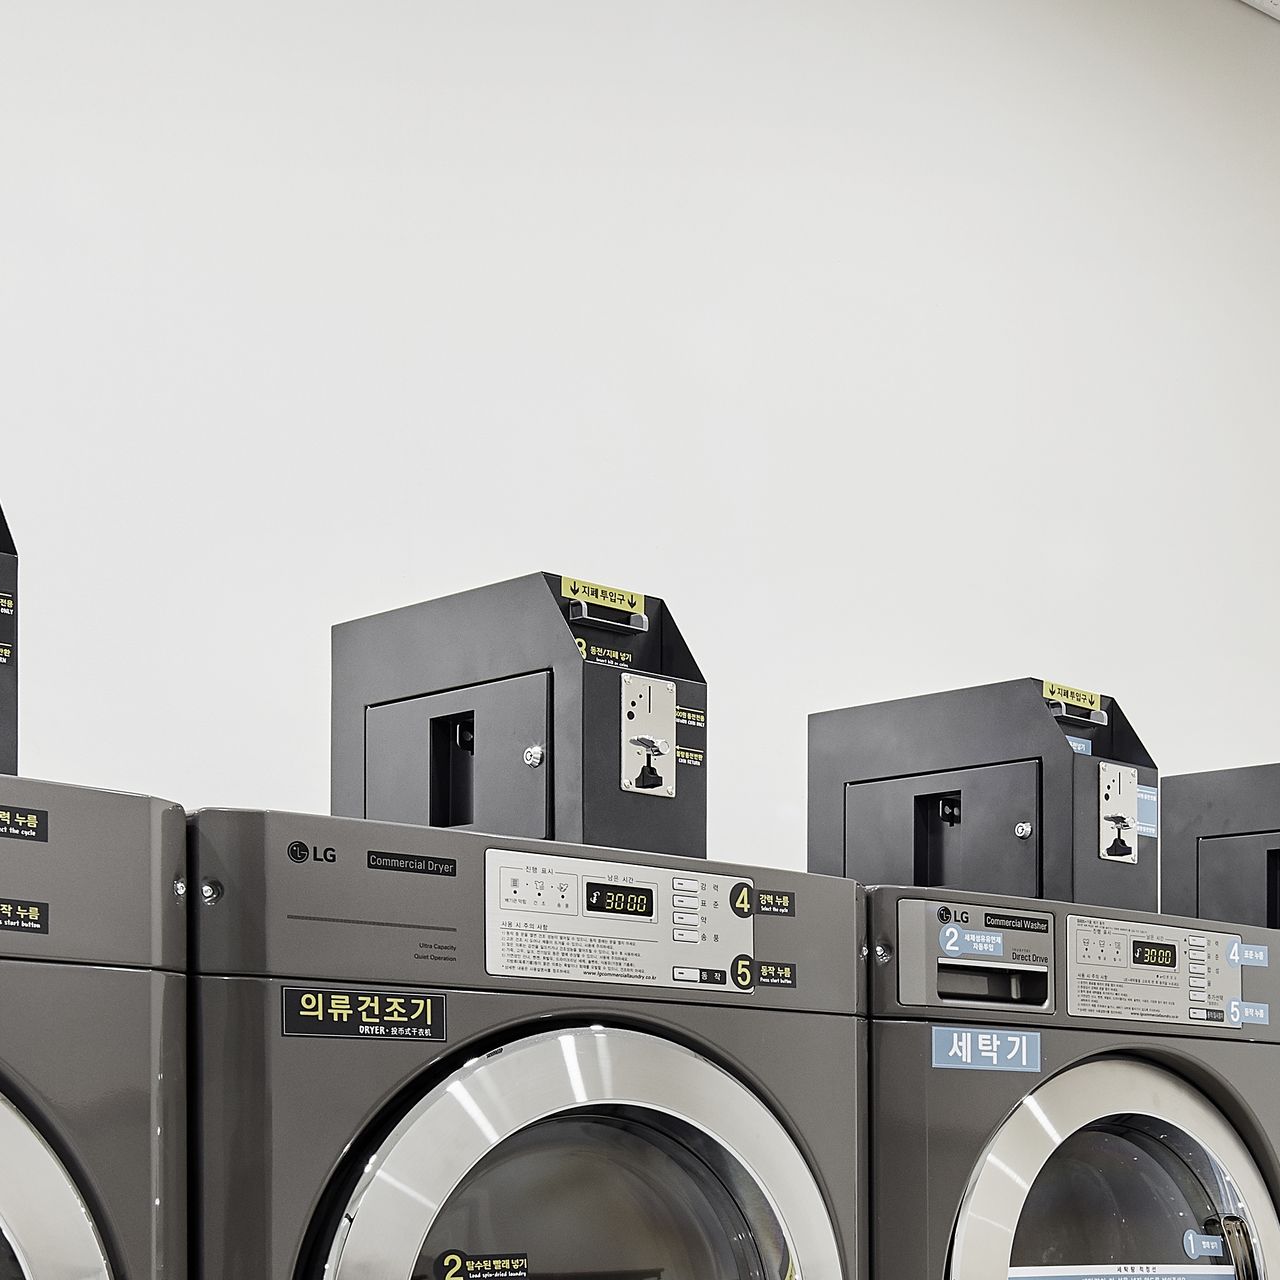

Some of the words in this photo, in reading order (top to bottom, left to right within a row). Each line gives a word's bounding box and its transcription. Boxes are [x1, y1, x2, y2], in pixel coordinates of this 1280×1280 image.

[581, 585, 599, 599] 지폐
[599, 589, 626, 605] 투입구
[14, 813, 39, 828] 누름
[21, 829, 37, 837] cycle
[313, 847, 337, 863] LG
[370, 854, 426, 870] Commercial
[428, 860, 454, 874] Dryer
[735, 887, 751, 913] 4
[775, 895, 790, 907] 누름
[16, 905, 40, 920] 누름
[953, 910, 969, 924] LG
[4, 918, 20, 927] start
[986, 916, 1023, 928] Commercial
[1023, 919, 1048, 931] Washer
[945, 927, 959, 951] 2
[1012, 952, 1031, 962] Direct
[1032, 953, 1049, 964] Drive
[1229, 942, 1240, 963] 4
[736, 960, 751, 986] 5
[776, 967, 791, 978] 누름
[1230, 1002, 1240, 1022] 5
[359, 1025, 385, 1035] DRYER
[948, 1032, 1027, 1066] 세탁기
[1188, 1233, 1195, 1254] 1
[466, 1260, 491, 1271] 탈수된
[492, 1259, 509, 1270] 빨래
[511, 1258, 528, 1269] 넣기
